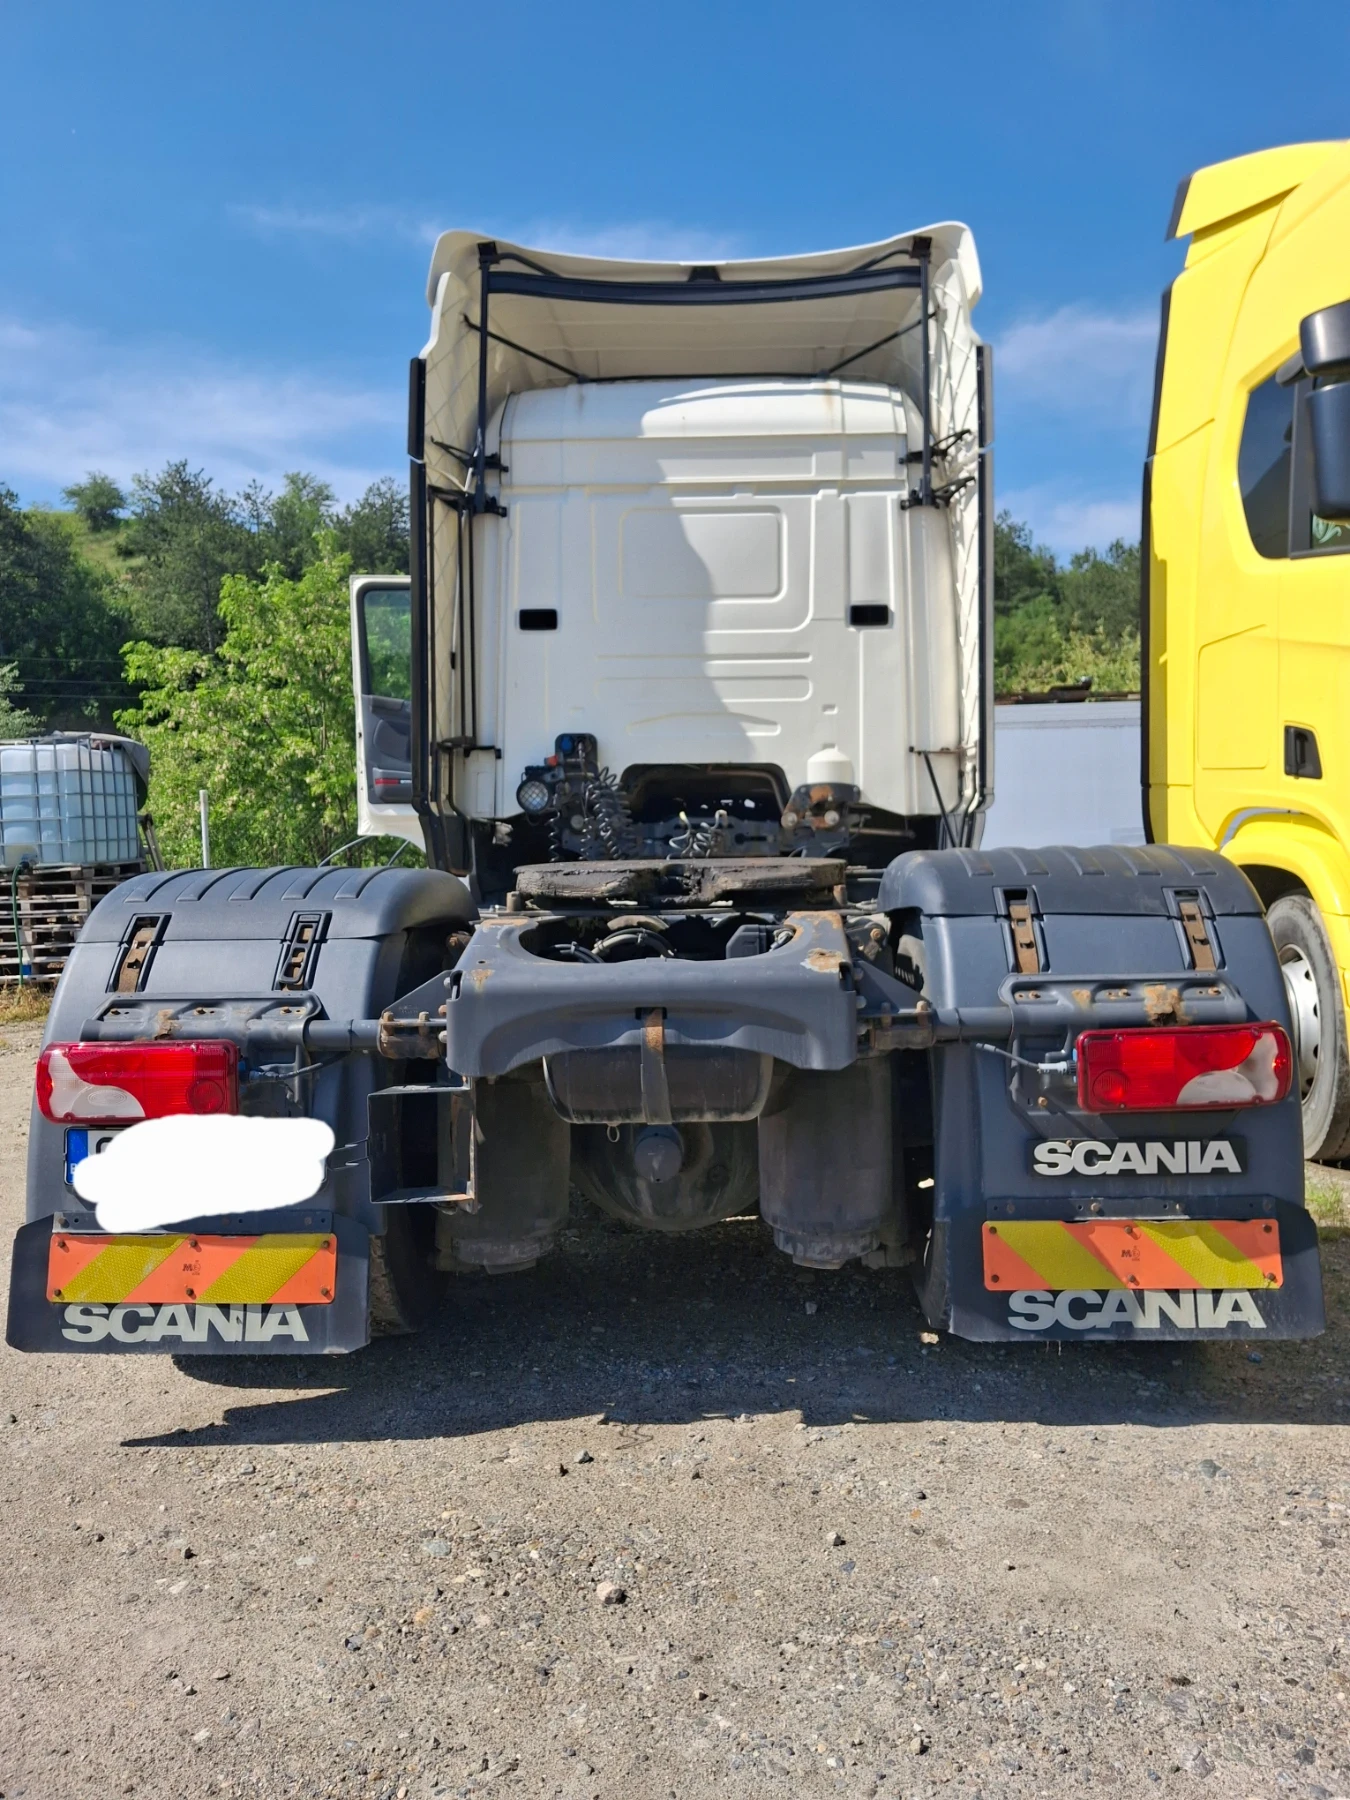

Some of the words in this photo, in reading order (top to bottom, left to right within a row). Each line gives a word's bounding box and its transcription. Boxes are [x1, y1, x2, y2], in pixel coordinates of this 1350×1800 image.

[1033, 1140, 1242, 1176] SCANIA
[61, 1302, 310, 1343] SCANIA
[1007, 1288, 1267, 1331] SCANIA
